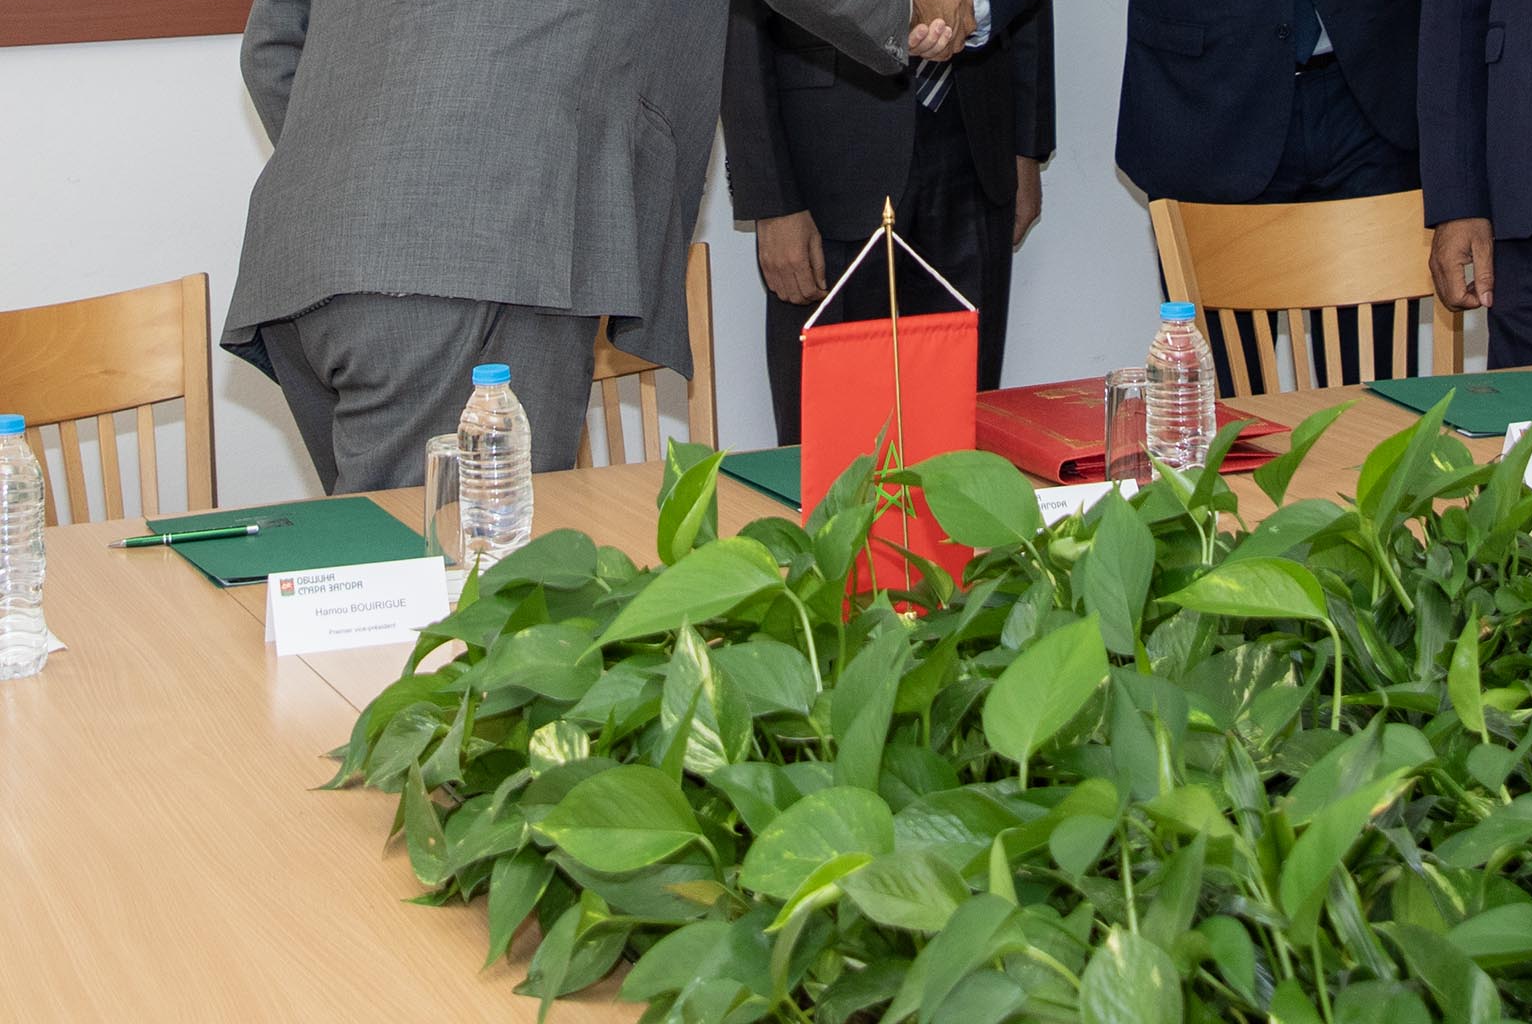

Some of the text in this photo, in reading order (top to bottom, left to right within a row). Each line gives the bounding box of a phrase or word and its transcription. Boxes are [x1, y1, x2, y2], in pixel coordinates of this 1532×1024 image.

[1040, 500, 1068, 510] АГОРА
[297, 573, 335, 585] ОБЩИНА
[298, 581, 364, 596] СТАРА ЗАГОРА
[315, 598, 407, 617] Hamou BOUIRIGUE
